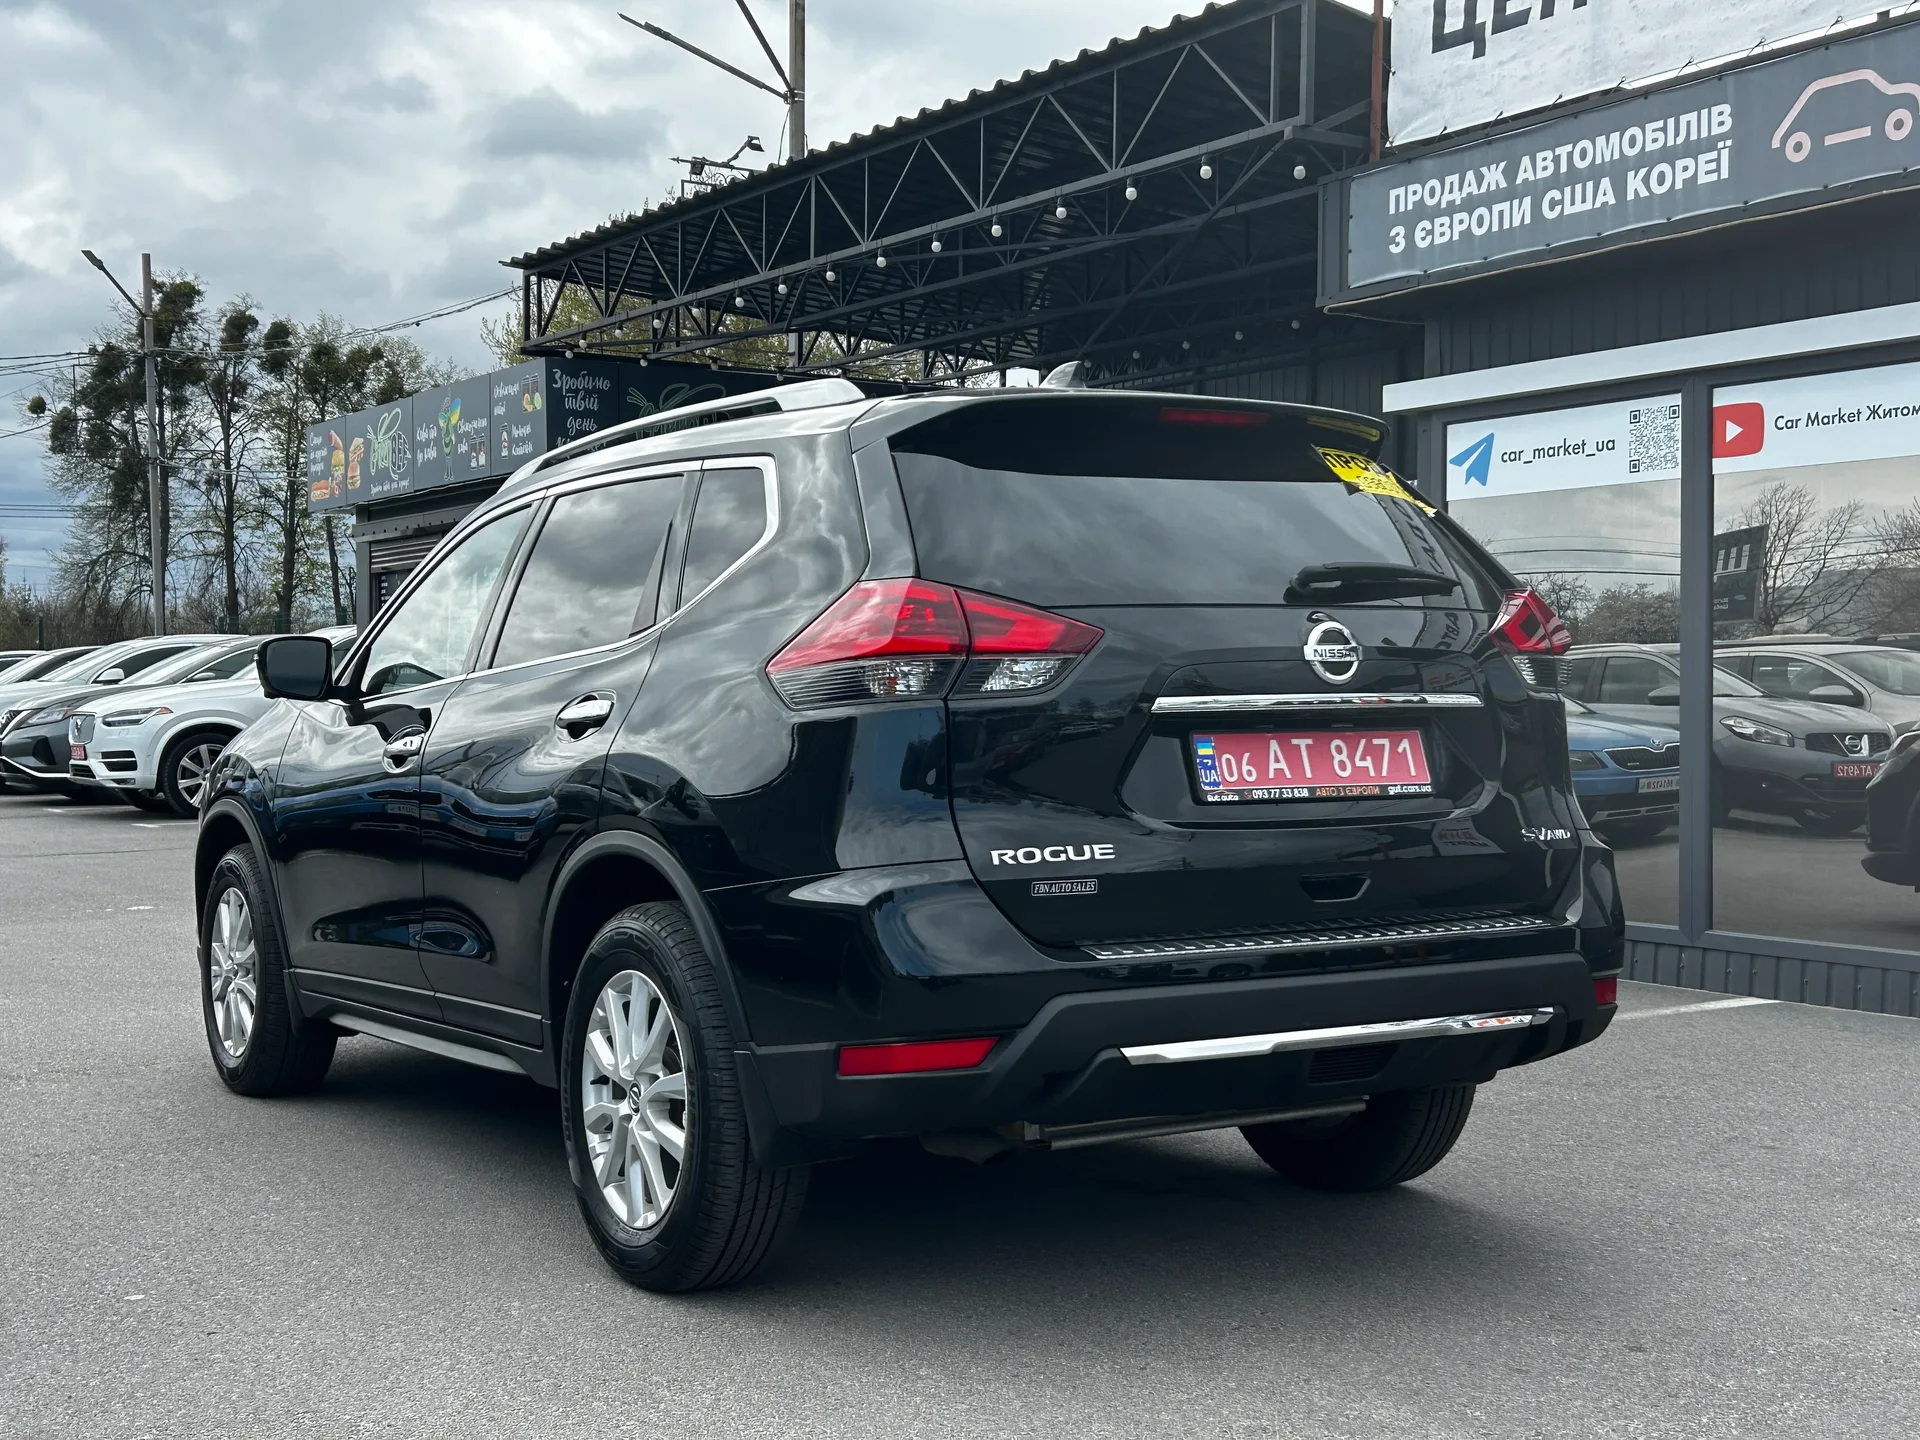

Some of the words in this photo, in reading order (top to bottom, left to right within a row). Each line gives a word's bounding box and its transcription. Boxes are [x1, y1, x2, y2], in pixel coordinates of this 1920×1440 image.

[1389, 160, 1507, 215] ПРОДАЖ
[1515, 103, 1733, 185] АВТОМОБІЛІВ
[1414, 196, 1532, 249] ЄВРОПИ
[1541, 176, 1616, 220] США
[1626, 139, 1733, 201] КОРЕЇ
[567, 416, 598, 436] день
[1774, 415, 1802, 431] Car
[1805, 407, 1862, 427] Market
[1500, 437, 1616, 464] car_market_ua
[1221, 752, 1257, 783] 06
[1268, 738, 1314, 779] AT
[1329, 737, 1417, 778] 8471
[1201, 769, 1219, 783] UA
[1252, 789, 1269, 799] 093
[1268, 788, 1280, 798] 77
[990, 843, 1116, 866] ROGUE
[1050, 882, 1072, 893] AUTO
[1072, 881, 1096, 893] SALES
